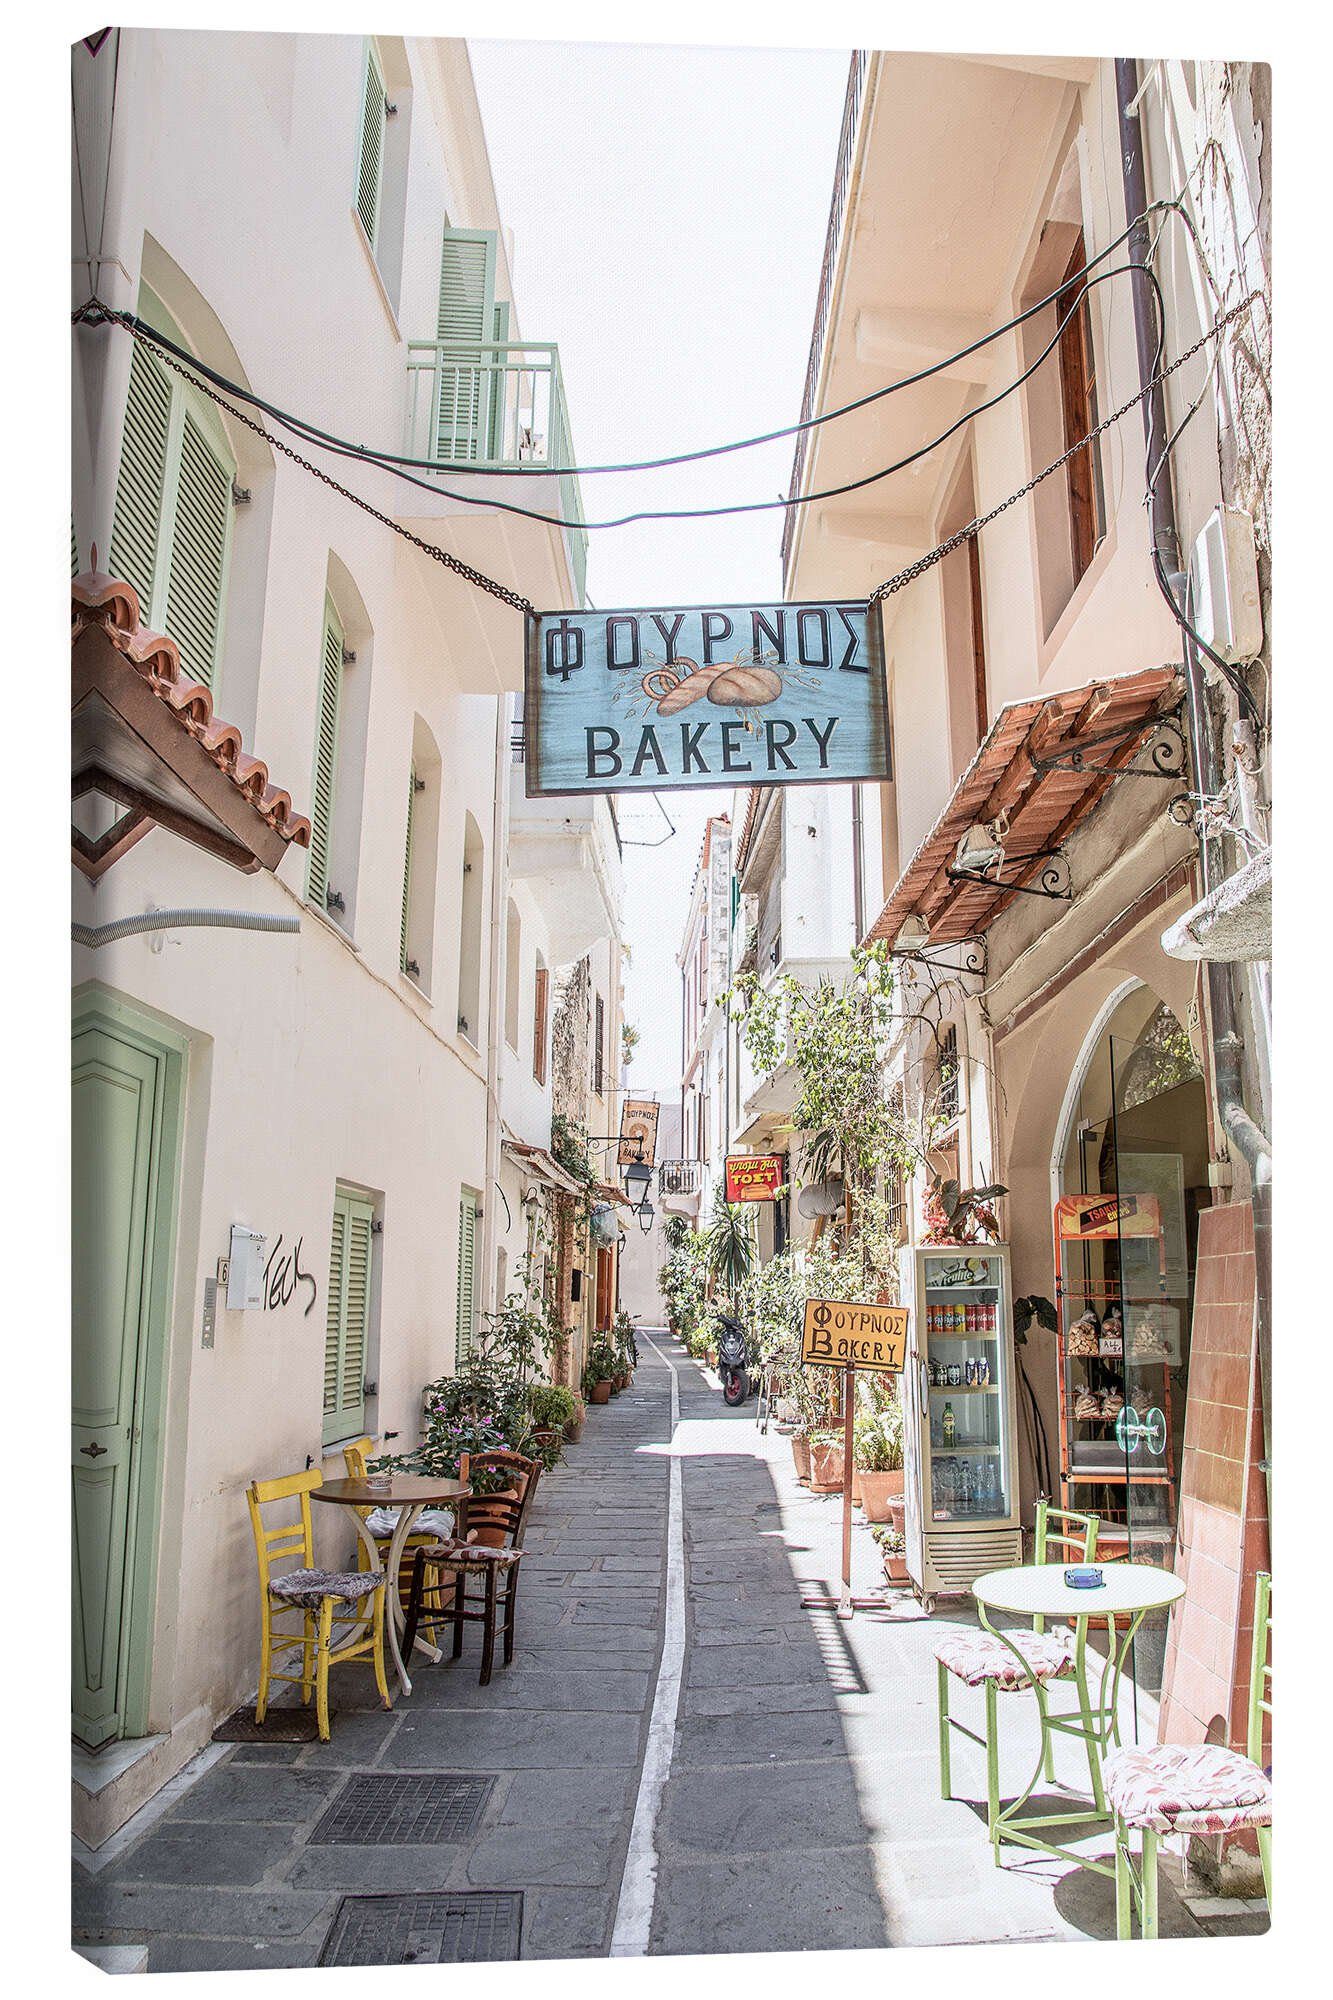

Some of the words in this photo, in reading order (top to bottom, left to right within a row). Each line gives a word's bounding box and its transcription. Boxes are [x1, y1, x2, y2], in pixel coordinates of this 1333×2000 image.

[545, 606, 873, 682] ΦΟΥΡΝΟΣ
[583, 717, 839, 779] BAKERY
[623, 1147, 650, 1159] BAKY
[731, 1172, 775, 1185] ΤΟΣΤ
[222, 1263, 228, 1282] 6
[813, 1301, 904, 1336] ΦΟΥΡΝΟΣ
